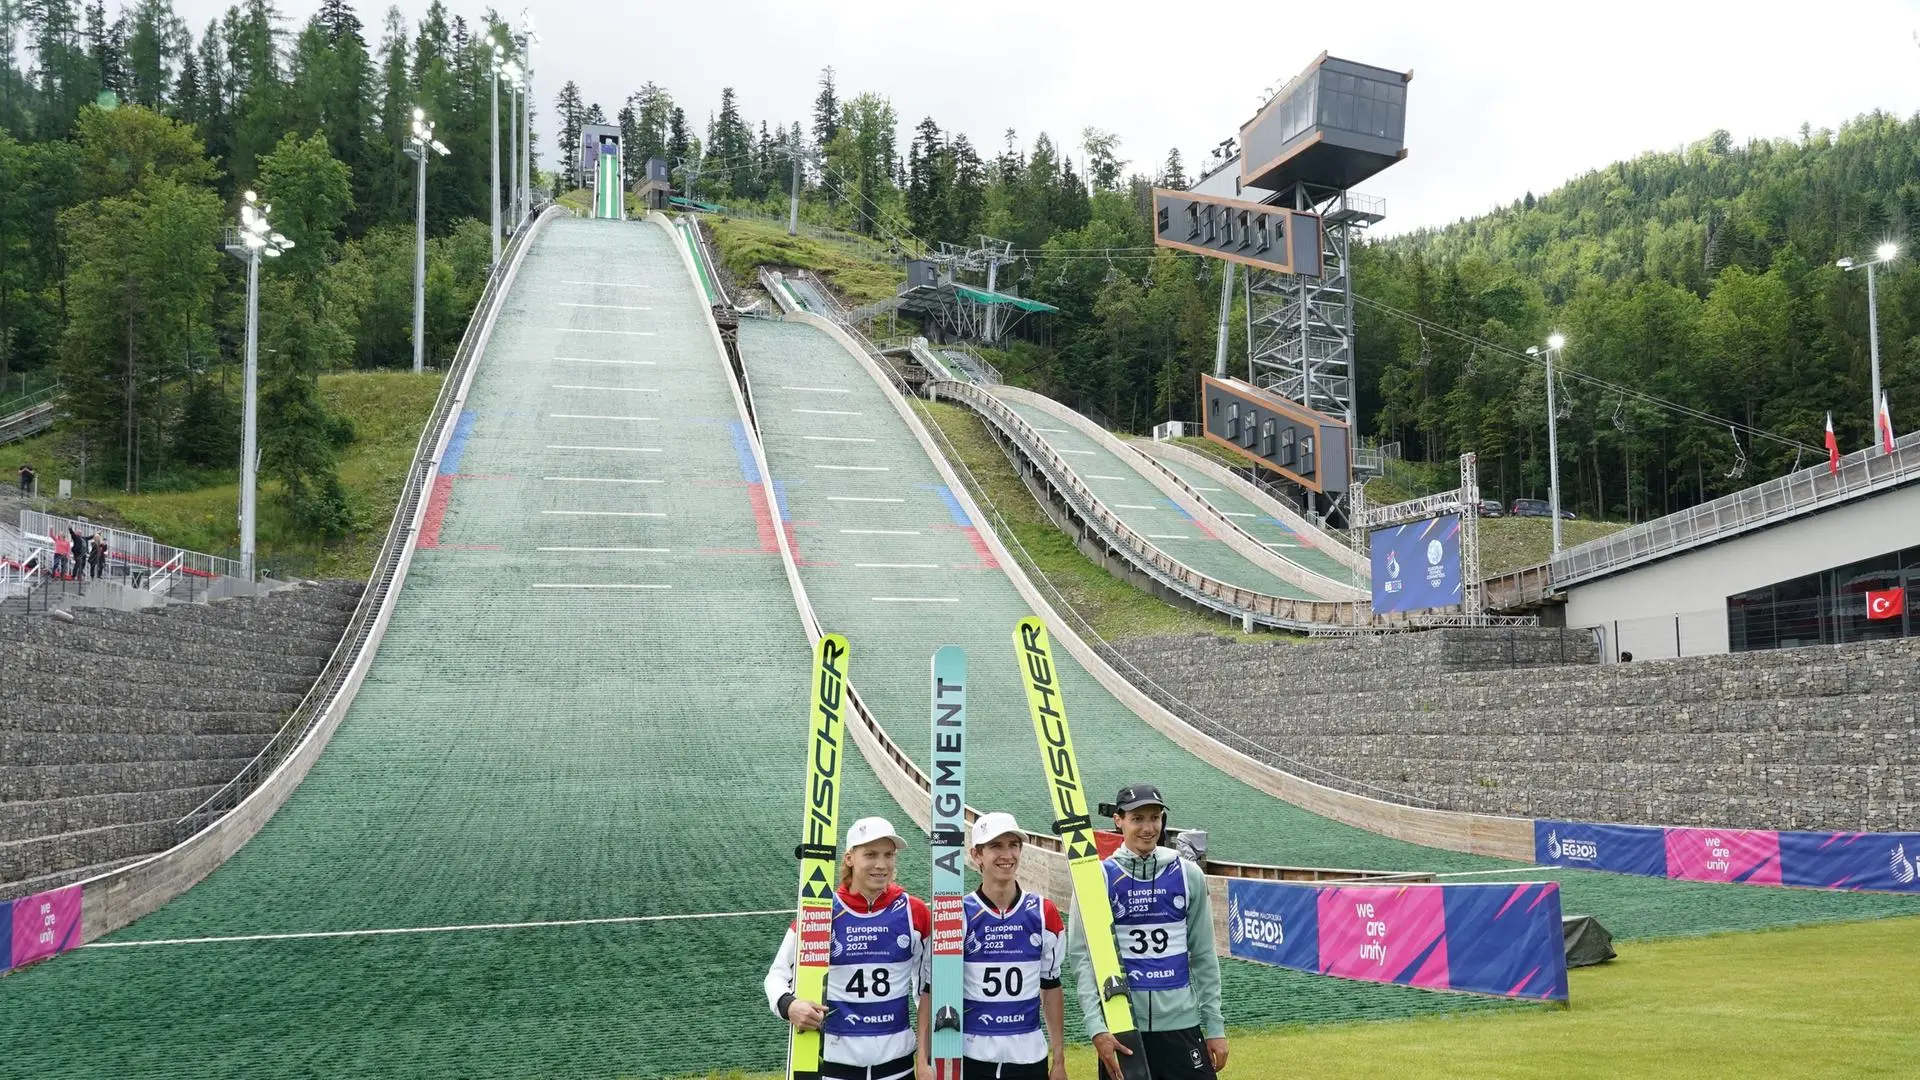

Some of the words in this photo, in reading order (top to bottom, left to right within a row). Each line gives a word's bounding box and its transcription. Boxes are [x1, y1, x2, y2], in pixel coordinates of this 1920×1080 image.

[1021, 622, 1081, 820] FISCHER
[810, 638, 845, 847] FISCHER
[1705, 837, 1721, 847] we
[1712, 847, 1730, 858] are
[1707, 858, 1730, 873] unity
[934, 899, 963, 911] Kronen
[1128, 896, 1157, 905] Games
[40, 902, 51, 915] we
[1128, 905, 1149, 913] 2023
[1356, 903, 1375, 918] we
[44, 914, 56, 926] are
[802, 910, 832, 921] Kronen
[933, 910, 963, 922] Zeitung
[801, 921, 832, 934] Zeitung
[846, 926, 889, 935] European
[984, 925, 1024, 934] European
[1366, 921, 1385, 937] are
[40, 927, 55, 945] unity
[846, 934, 878, 943] Games
[934, 928, 963, 940] Kronen
[985, 932, 1013, 941] Games
[801, 939, 830, 951] Kronen
[846, 943, 868, 951] 2023
[933, 939, 963, 952] Zeitung
[984, 941, 1004, 949] 2023
[1128, 928, 1169, 954] 39
[800, 951, 830, 964] Zeitung
[1360, 940, 1387, 966] unity
[1146, 969, 1175, 979] ORLEN
[845, 968, 890, 998] 48
[982, 967, 1023, 997] 50
[863, 1014, 894, 1023] ORLEN
[995, 1014, 1024, 1023] ORLEN
